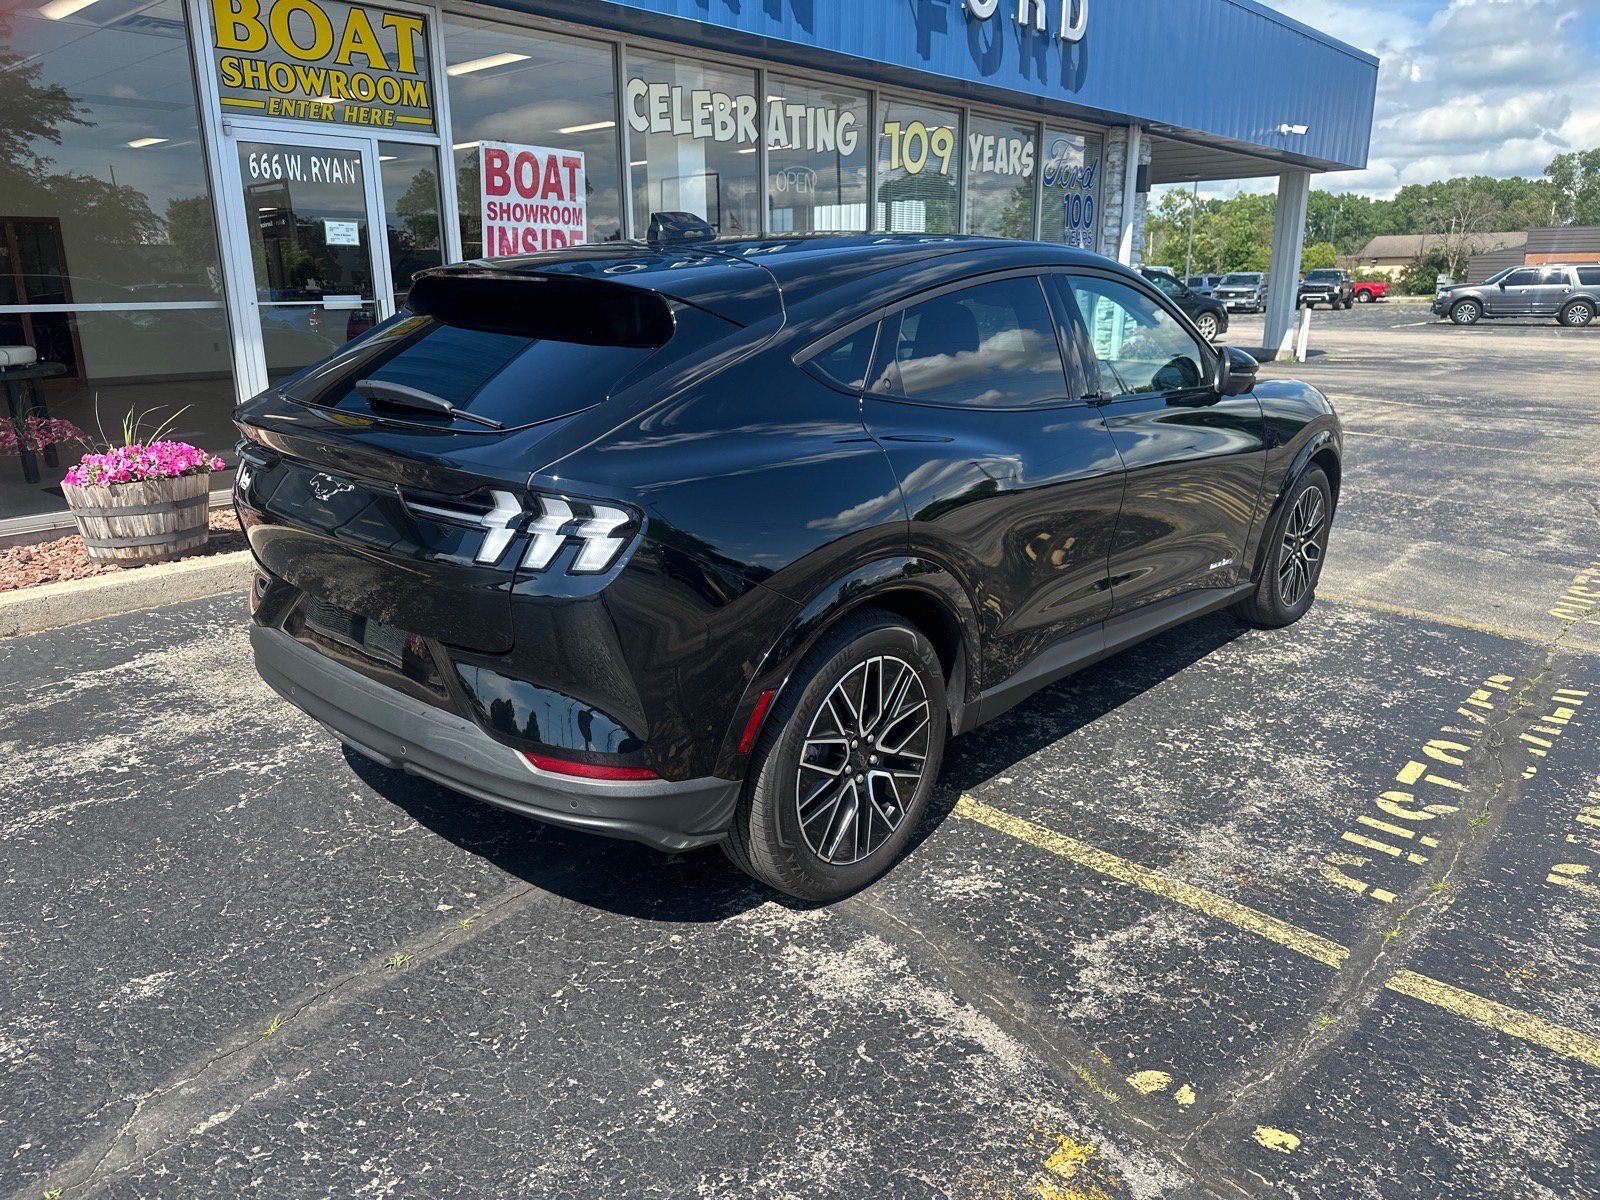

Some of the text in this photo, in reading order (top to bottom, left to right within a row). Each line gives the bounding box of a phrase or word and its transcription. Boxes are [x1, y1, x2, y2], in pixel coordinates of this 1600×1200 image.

[211, 0, 424, 75] BOAT
[220, 56, 429, 108] SHOWROOM
[267, 97, 396, 126] ENTER HERE
[249, 152, 355, 184] 666 W. RYAN
[884, 120, 955, 175] 109
[968, 132, 1035, 178] YEARS
[1042, 138, 1099, 190] Ford
[484, 147, 582, 202] BOAT
[775, 170, 817, 194] OPEN
[486, 200, 583, 226] SHOWROOM
[1064, 192, 1094, 230] 100
